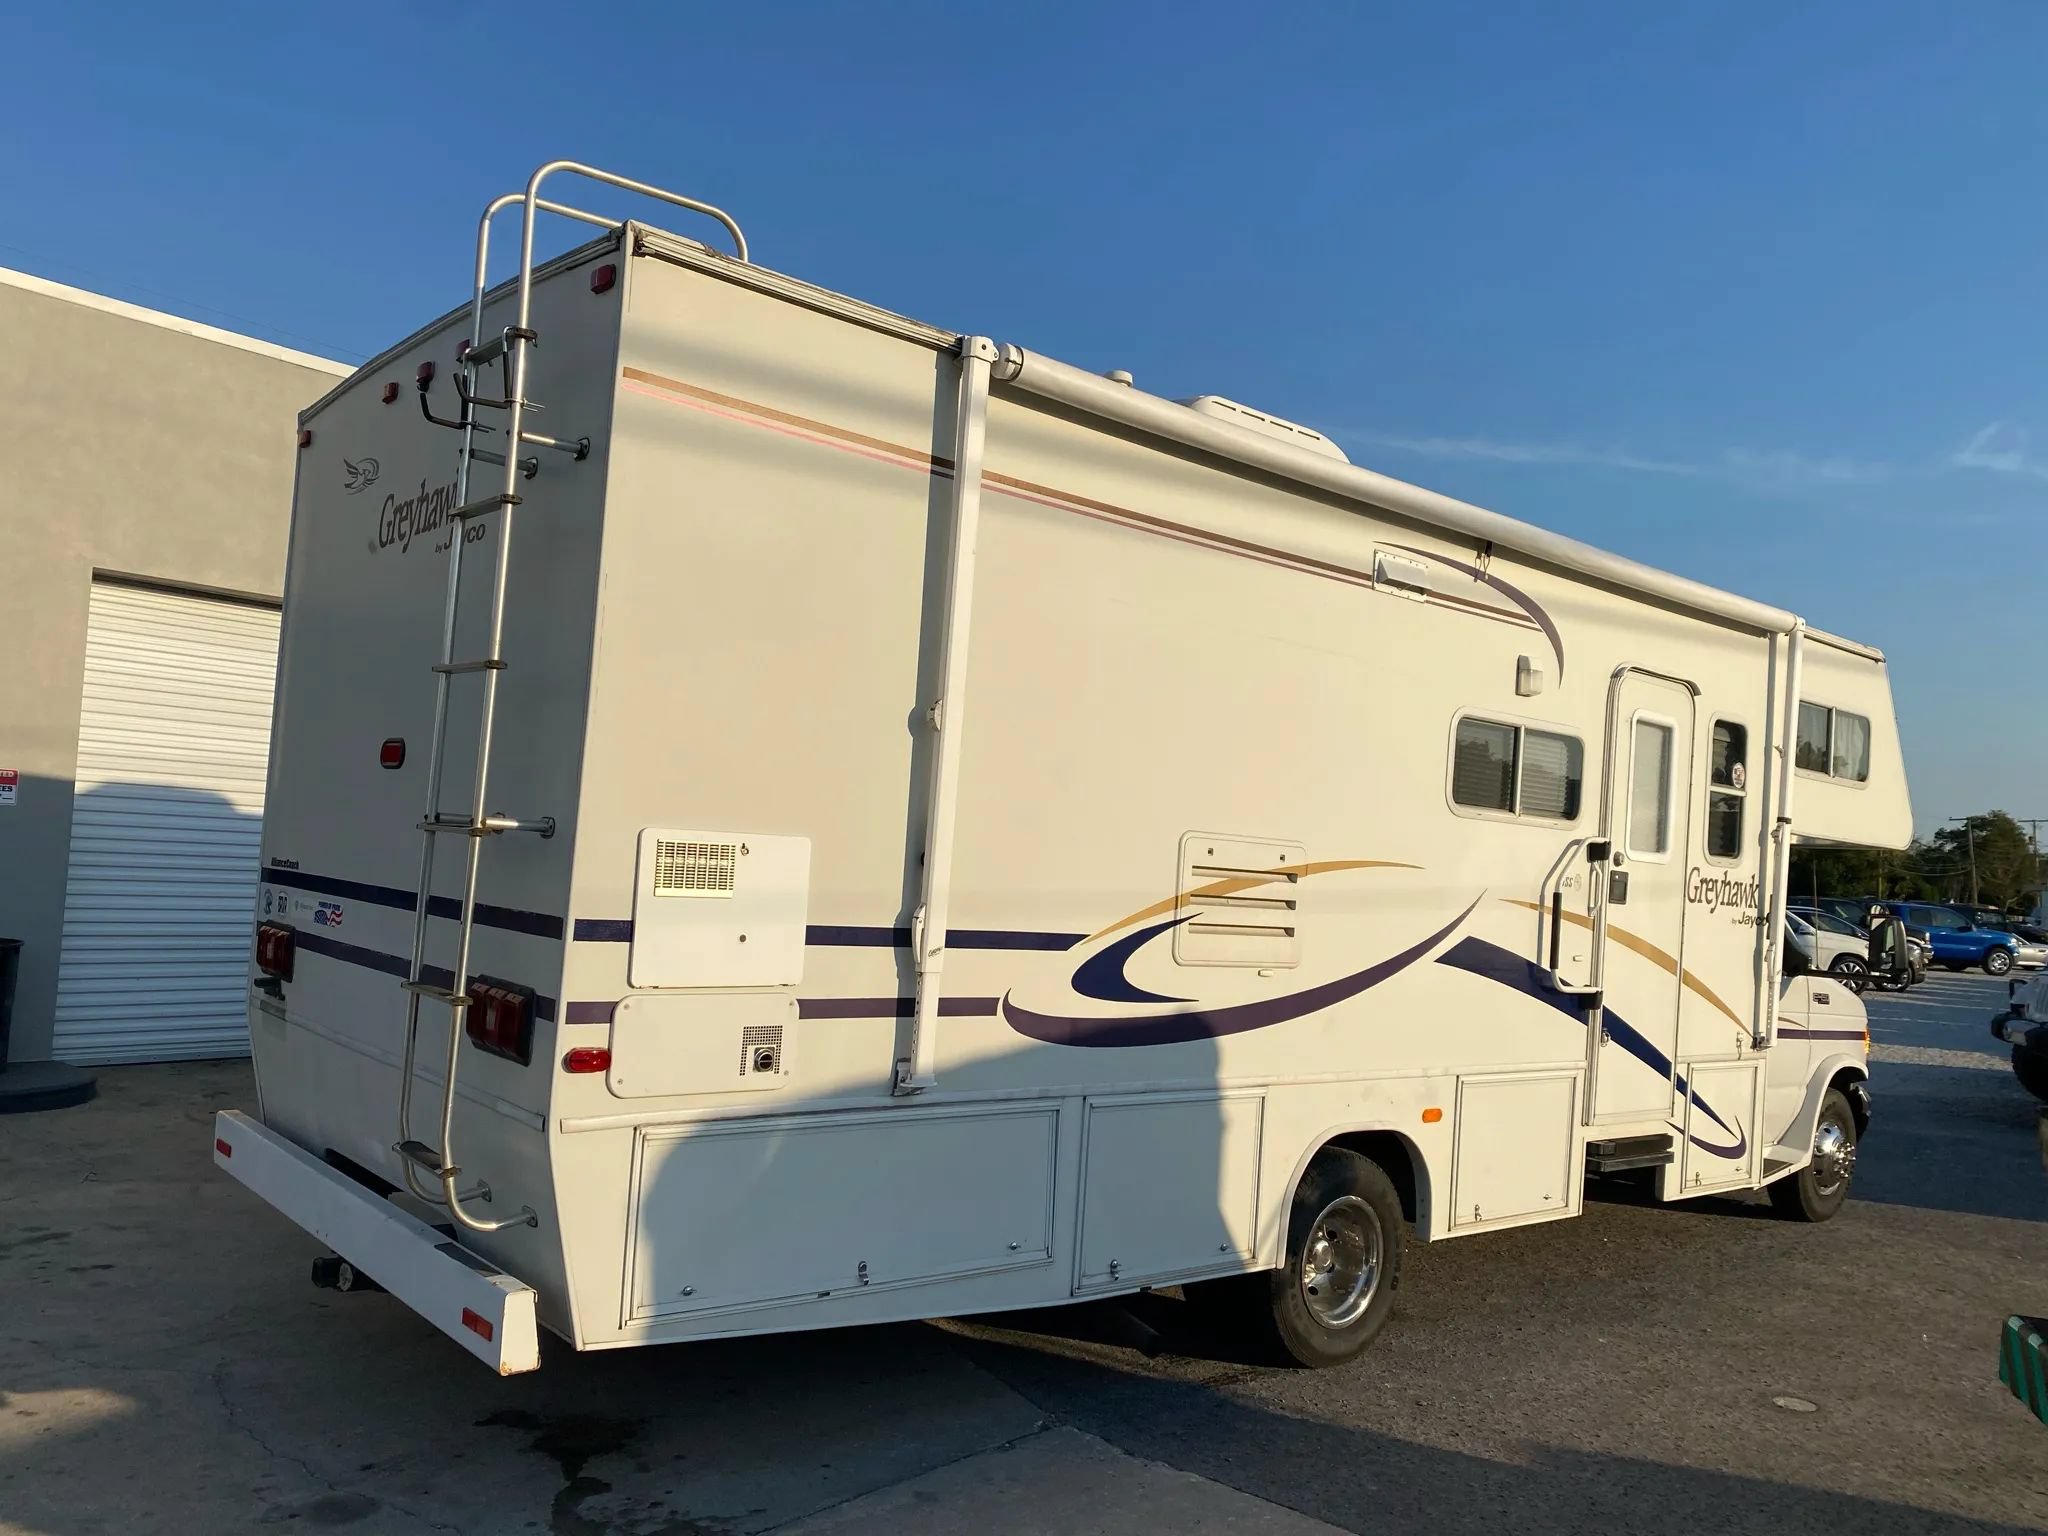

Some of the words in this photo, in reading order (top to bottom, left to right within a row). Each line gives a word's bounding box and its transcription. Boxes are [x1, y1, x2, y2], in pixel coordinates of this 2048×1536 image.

[378, 467, 459, 554] Greyhaw
[443, 523, 486, 551] Jco
[1686, 866, 1760, 914] Greyhawk
[1738, 911, 1767, 928] Jayco
